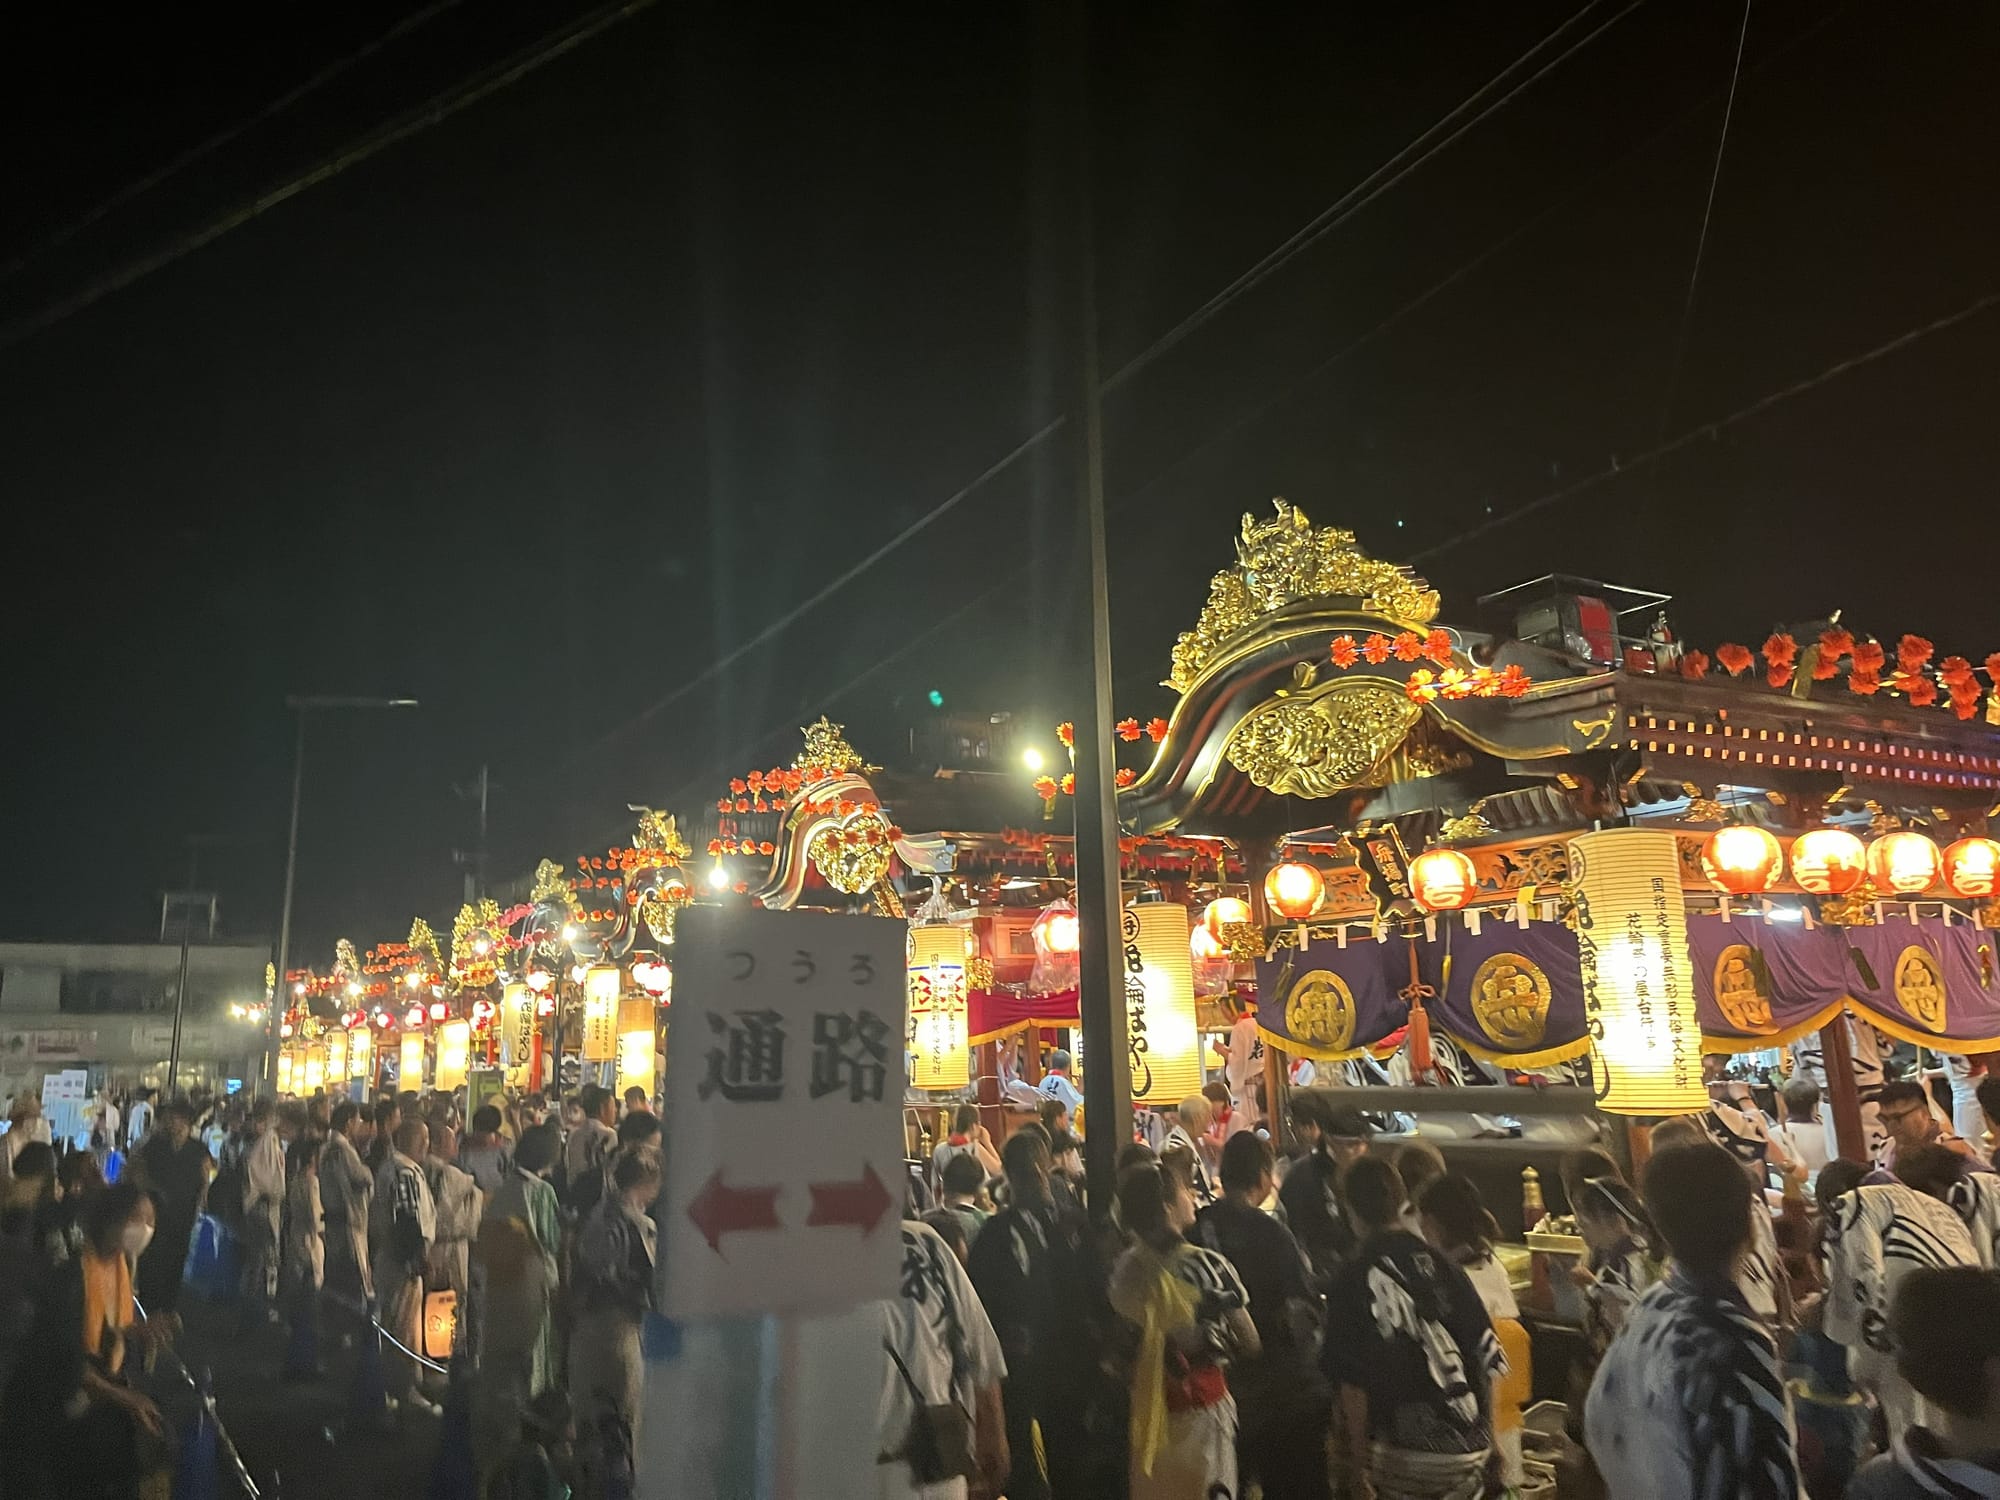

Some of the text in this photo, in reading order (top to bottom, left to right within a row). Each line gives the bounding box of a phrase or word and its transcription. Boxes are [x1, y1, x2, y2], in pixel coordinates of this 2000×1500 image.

[725, 949, 876, 986] つうろ
[697, 1008, 890, 1103] 通路
